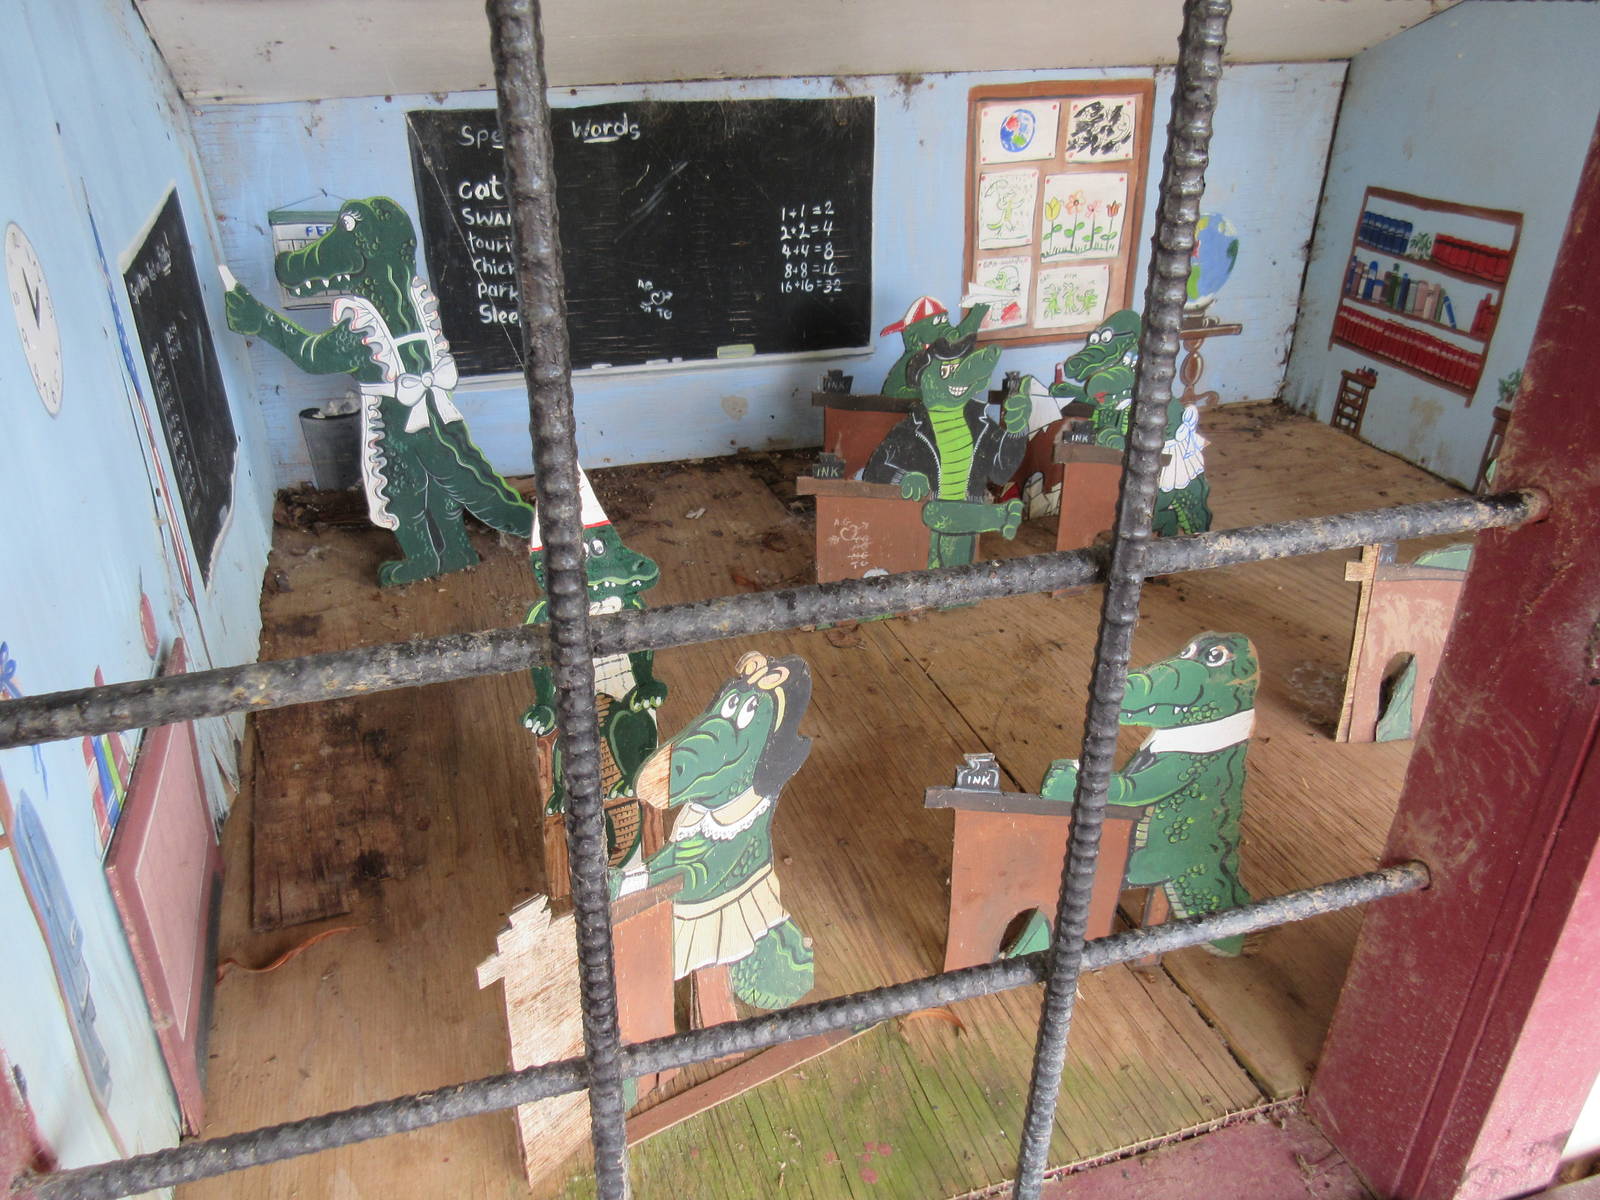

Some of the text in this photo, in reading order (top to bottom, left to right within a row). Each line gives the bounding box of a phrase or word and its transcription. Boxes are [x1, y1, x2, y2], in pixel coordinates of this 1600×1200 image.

[459, 125, 503, 149] Spe
[462, 208, 511, 226] SWA
[468, 231, 512, 253] touri
[479, 304, 522, 328] Slee
[1071, 434, 1089, 443] INK
[816, 465, 839, 478] INK
[966, 773, 991, 787] INK
